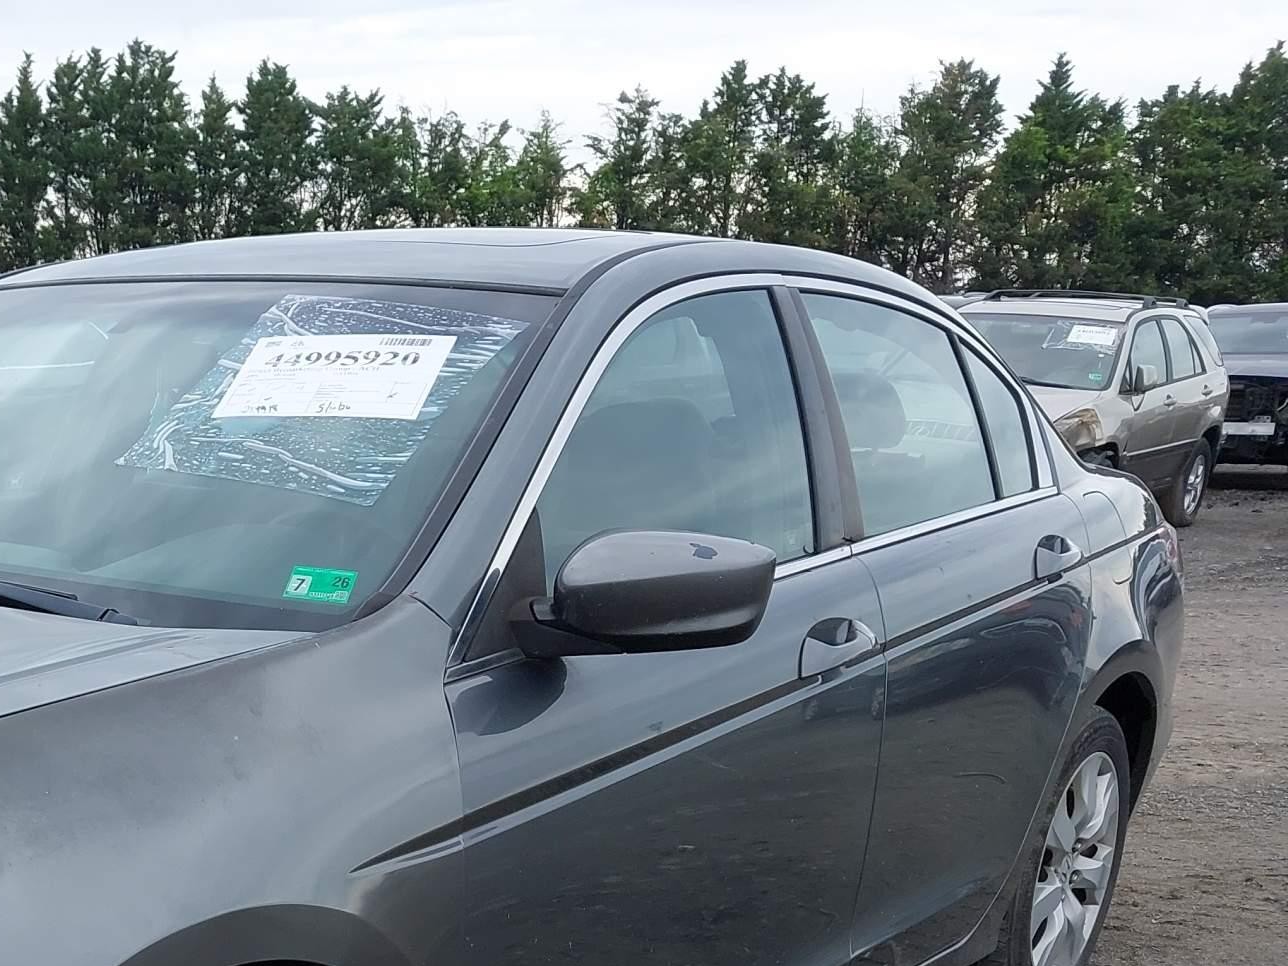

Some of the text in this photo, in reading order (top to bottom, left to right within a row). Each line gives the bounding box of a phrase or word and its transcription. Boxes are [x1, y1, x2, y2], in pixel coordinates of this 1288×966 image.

[264, 350, 421, 368] 44995920
[294, 578, 306, 591] 7
[332, 576, 350, 588] 26
